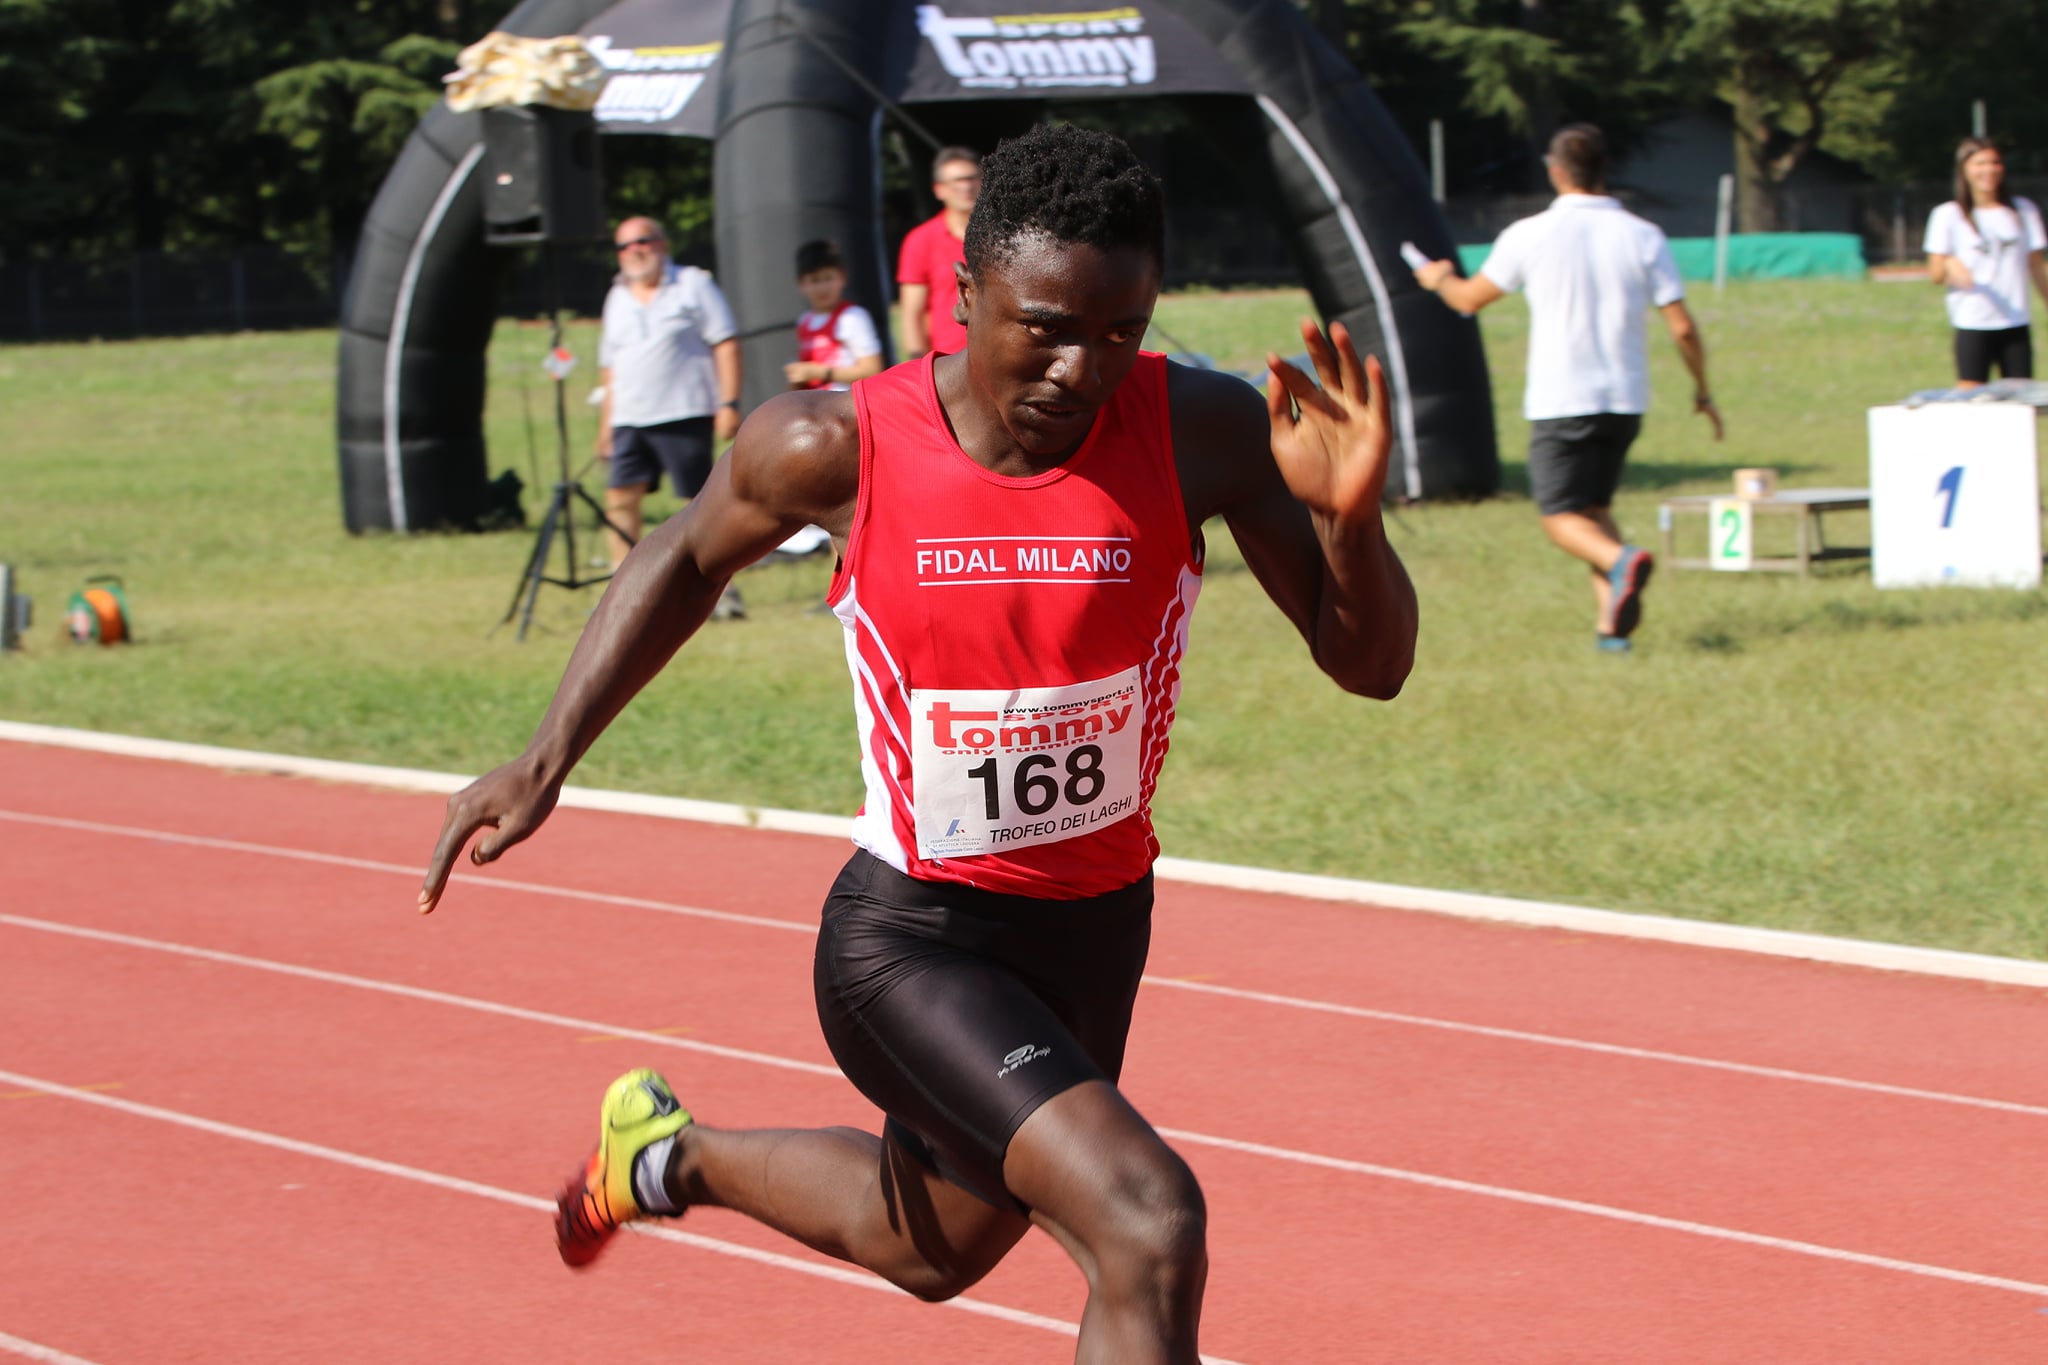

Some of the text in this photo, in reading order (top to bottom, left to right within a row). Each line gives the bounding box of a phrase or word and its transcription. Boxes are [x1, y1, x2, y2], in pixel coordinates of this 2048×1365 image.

[915, 5, 1156, 84] tommy
[1935, 466, 1966, 528] 1
[1720, 509, 1743, 558] 2
[916, 547, 1132, 574] FIDAL MILANO
[1003, 685, 1134, 714] www.tommysport.it
[926, 702, 1133, 748] tommy
[1005, 734, 1098, 753] running
[967, 744, 1106, 820] 168
[989, 796, 1132, 843] TROFEO DEI LAGHI
